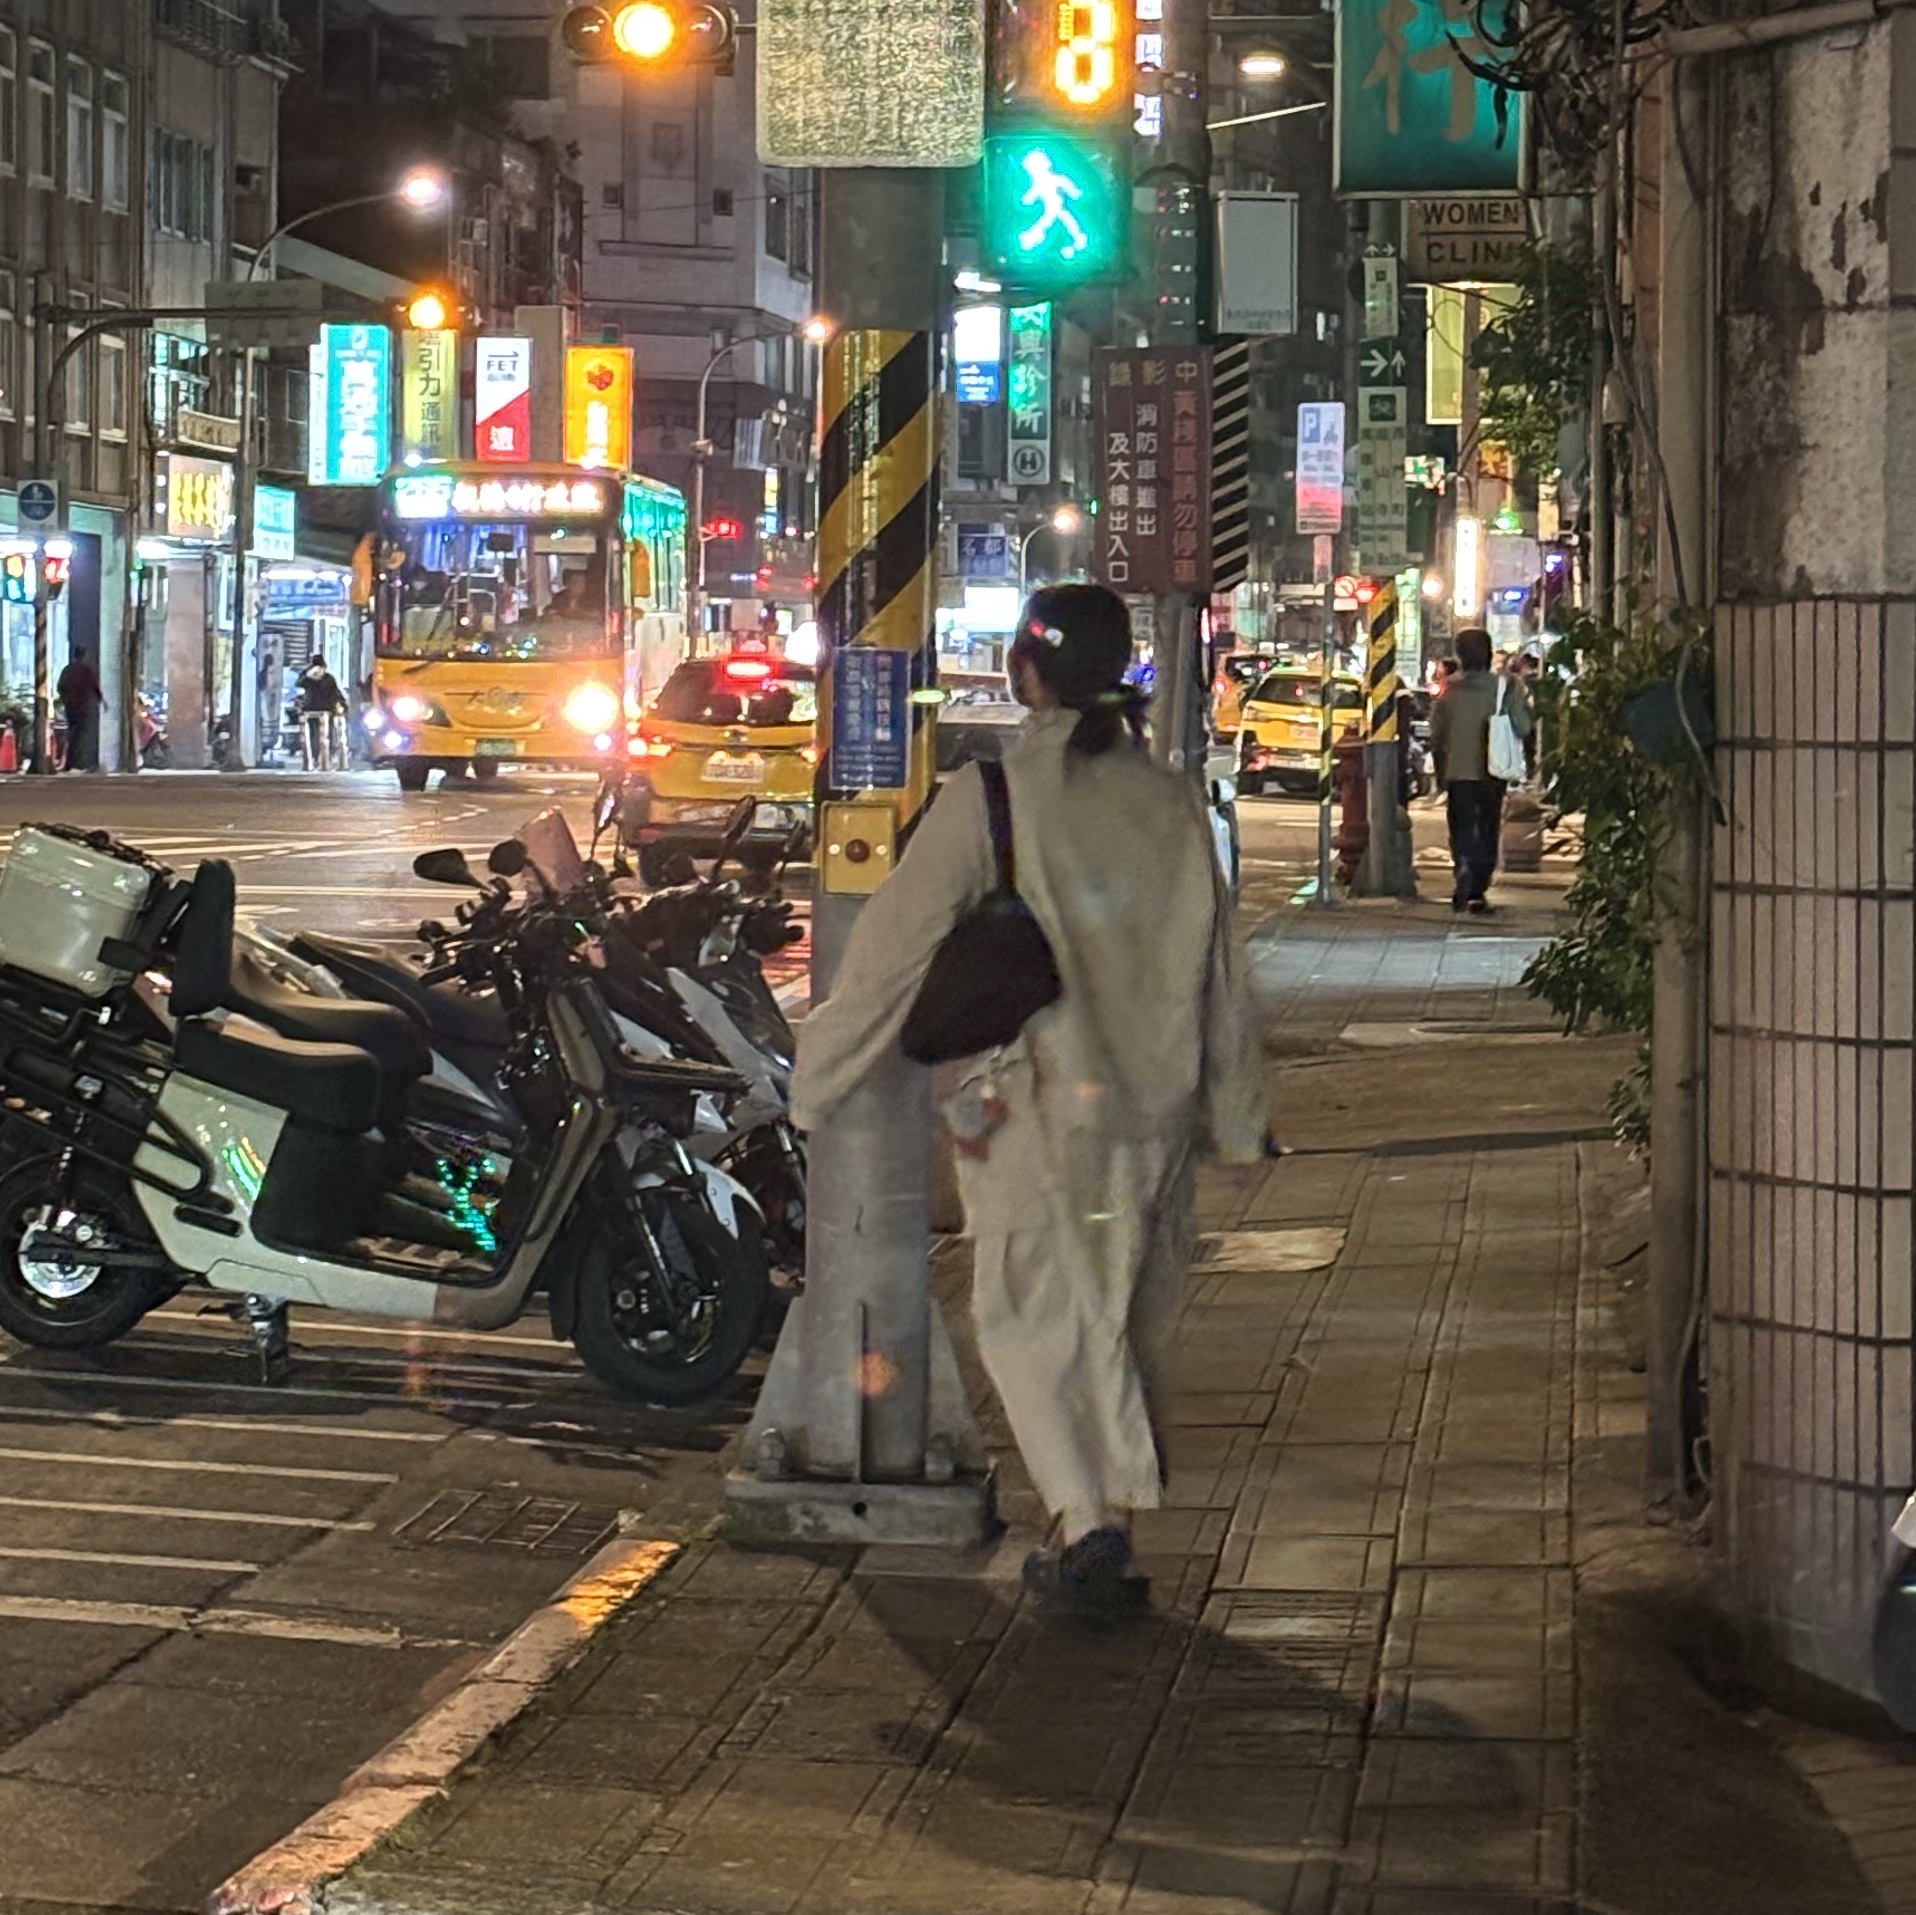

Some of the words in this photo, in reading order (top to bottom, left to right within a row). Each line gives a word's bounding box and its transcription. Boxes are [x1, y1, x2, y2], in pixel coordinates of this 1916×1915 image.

[1423, 201, 1520, 225] WOMEN
[486, 359, 519, 372] FET
[1107, 432, 1131, 583] 及大樓出入口
[1135, 403, 1158, 536] 消防車進出
